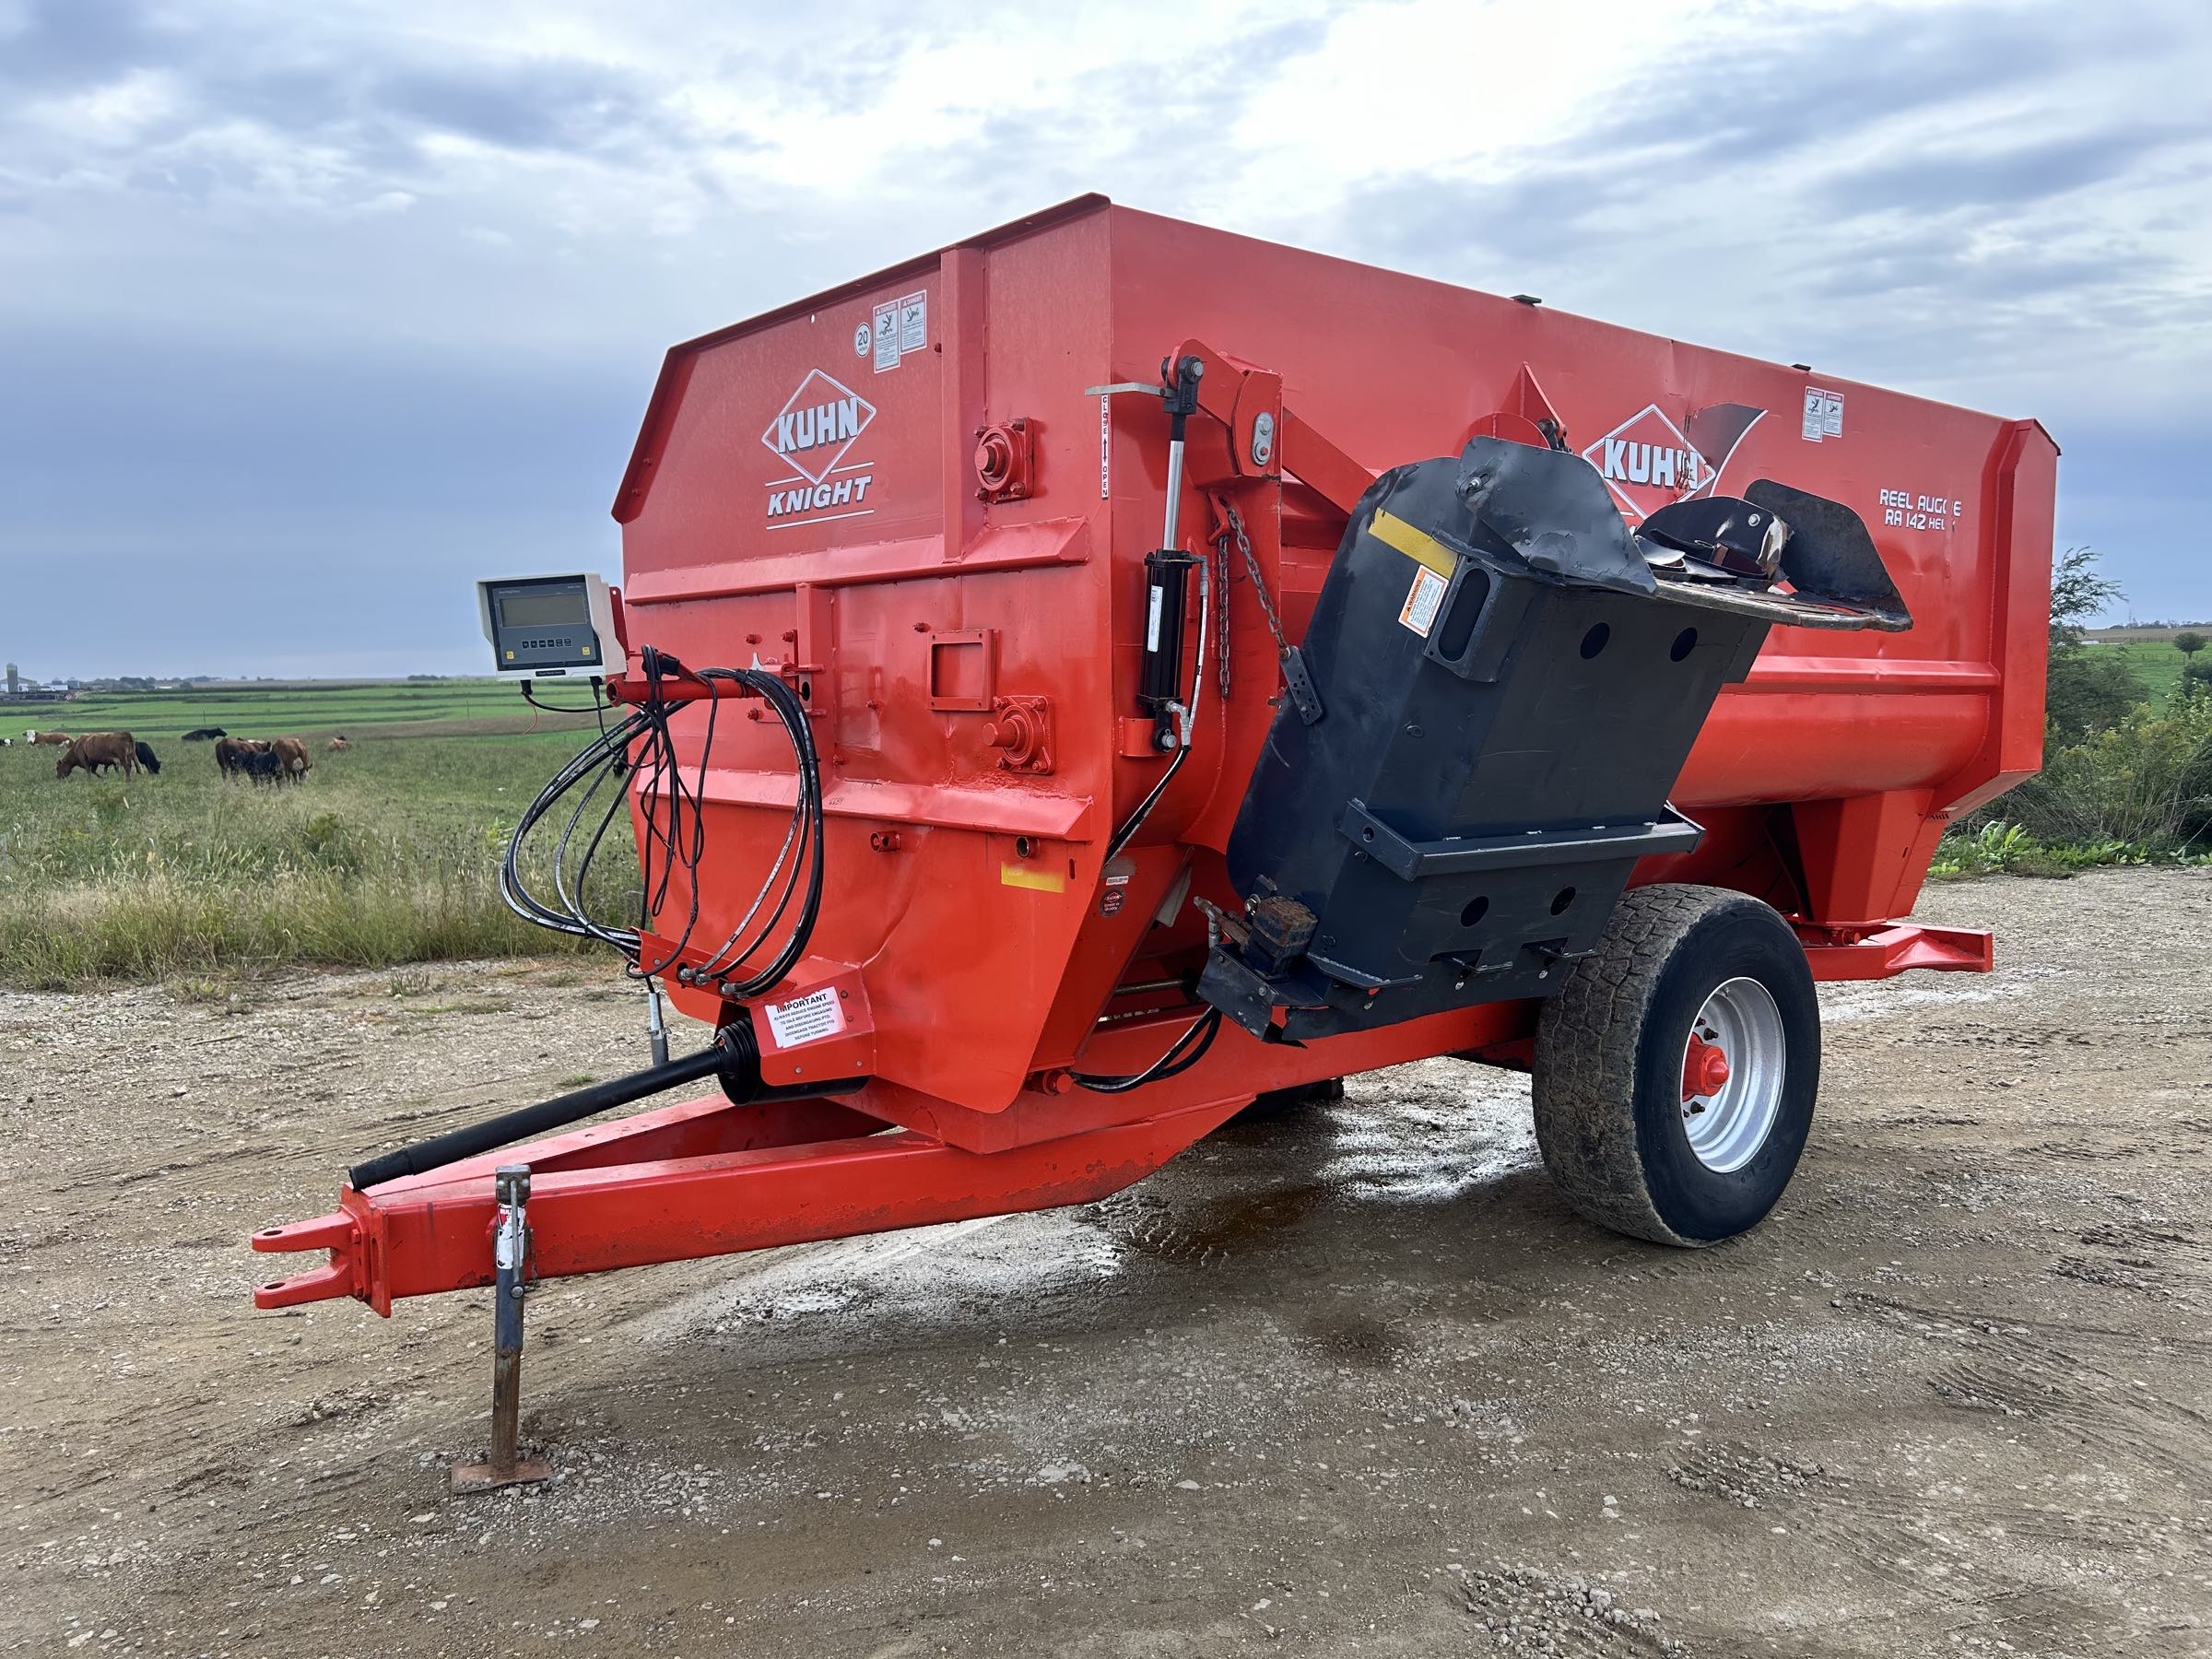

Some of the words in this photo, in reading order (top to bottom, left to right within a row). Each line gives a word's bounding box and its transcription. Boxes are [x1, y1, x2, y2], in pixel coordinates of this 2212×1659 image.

[858, 330, 868, 347] 20
[778, 396, 858, 453] KUHN
[1604, 437, 1698, 490] KUHN
[767, 475, 872, 518] KNIGHT
[1880, 488, 1913, 510] REEL
[1885, 509, 1903, 526] RA
[1905, 512, 1926, 531] 142
[1408, 580, 1421, 606] WARNING
[774, 1013, 791, 1021] ALWAYS
[792, 1007, 806, 1017] REDUCE
[807, 1004, 822, 1012] ENGINE
[777, 994, 827, 1014] IMPORTANT
[794, 1017, 821, 1028] DISENGAGING
[795, 1014, 811, 1022] BEFORE
[812, 1007, 833, 1017] ENGAGING
[785, 1027, 808, 1037] DISENGAGE
[808, 1021, 827, 1030] TRACTOR
[794, 1032, 811, 1041] BEFORE
